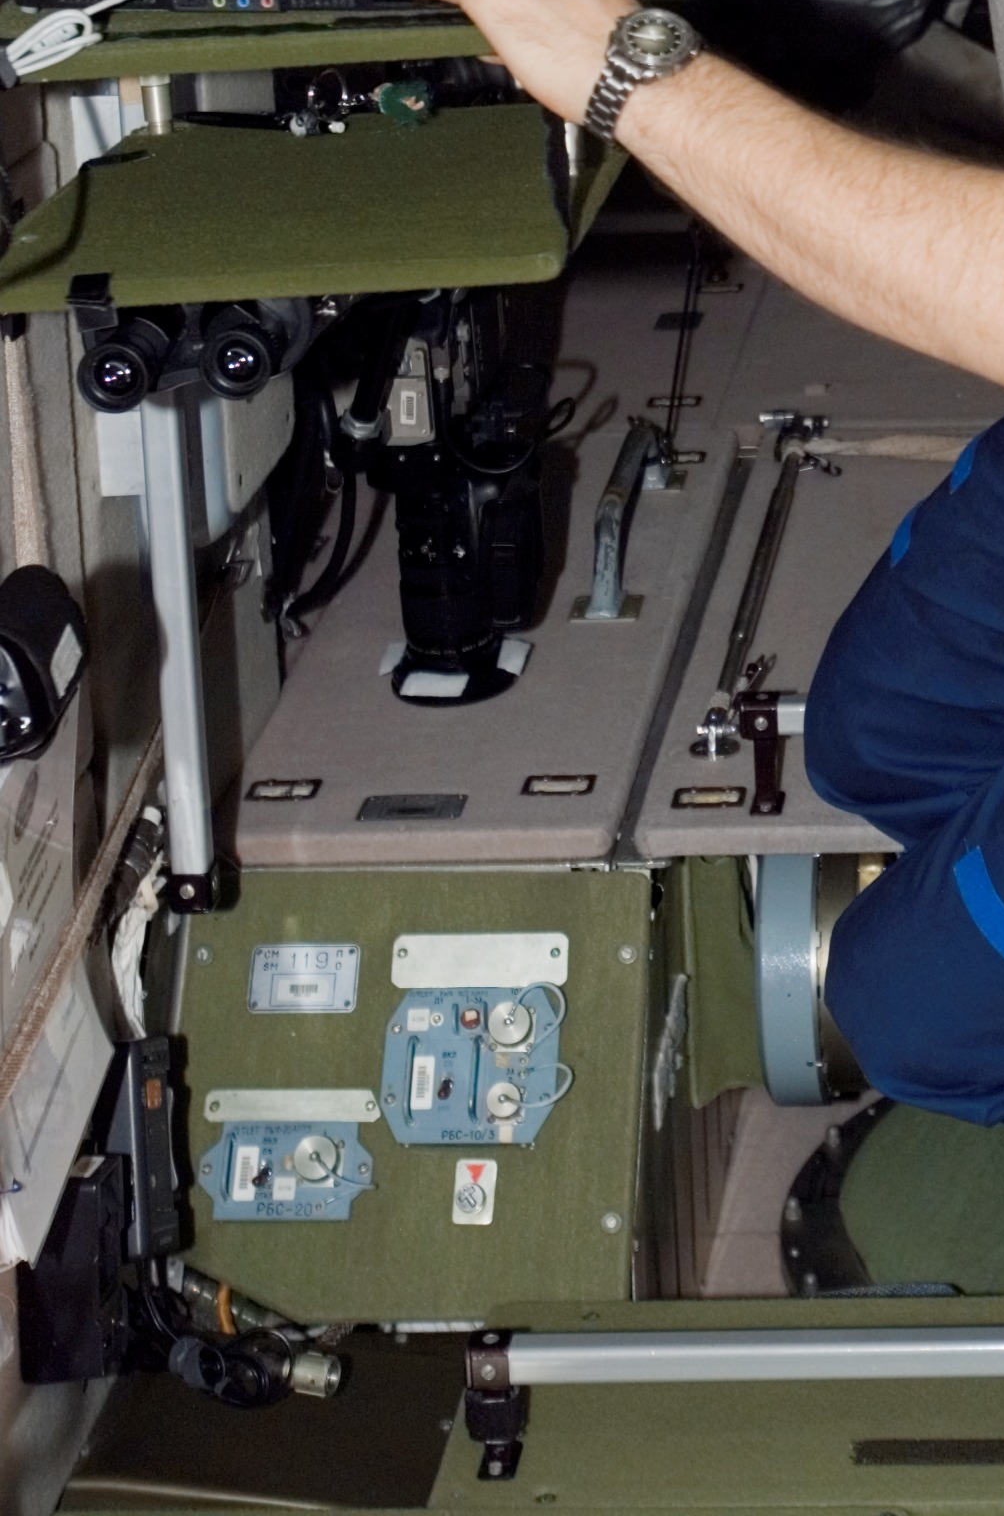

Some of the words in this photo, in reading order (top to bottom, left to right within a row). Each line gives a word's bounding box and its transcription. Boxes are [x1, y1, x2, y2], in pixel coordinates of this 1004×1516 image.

[291, 952, 329, 970] 119
[440, 1129, 496, 1141] РБС-10/3
[257, 1203, 313, 1217] РБС-20
